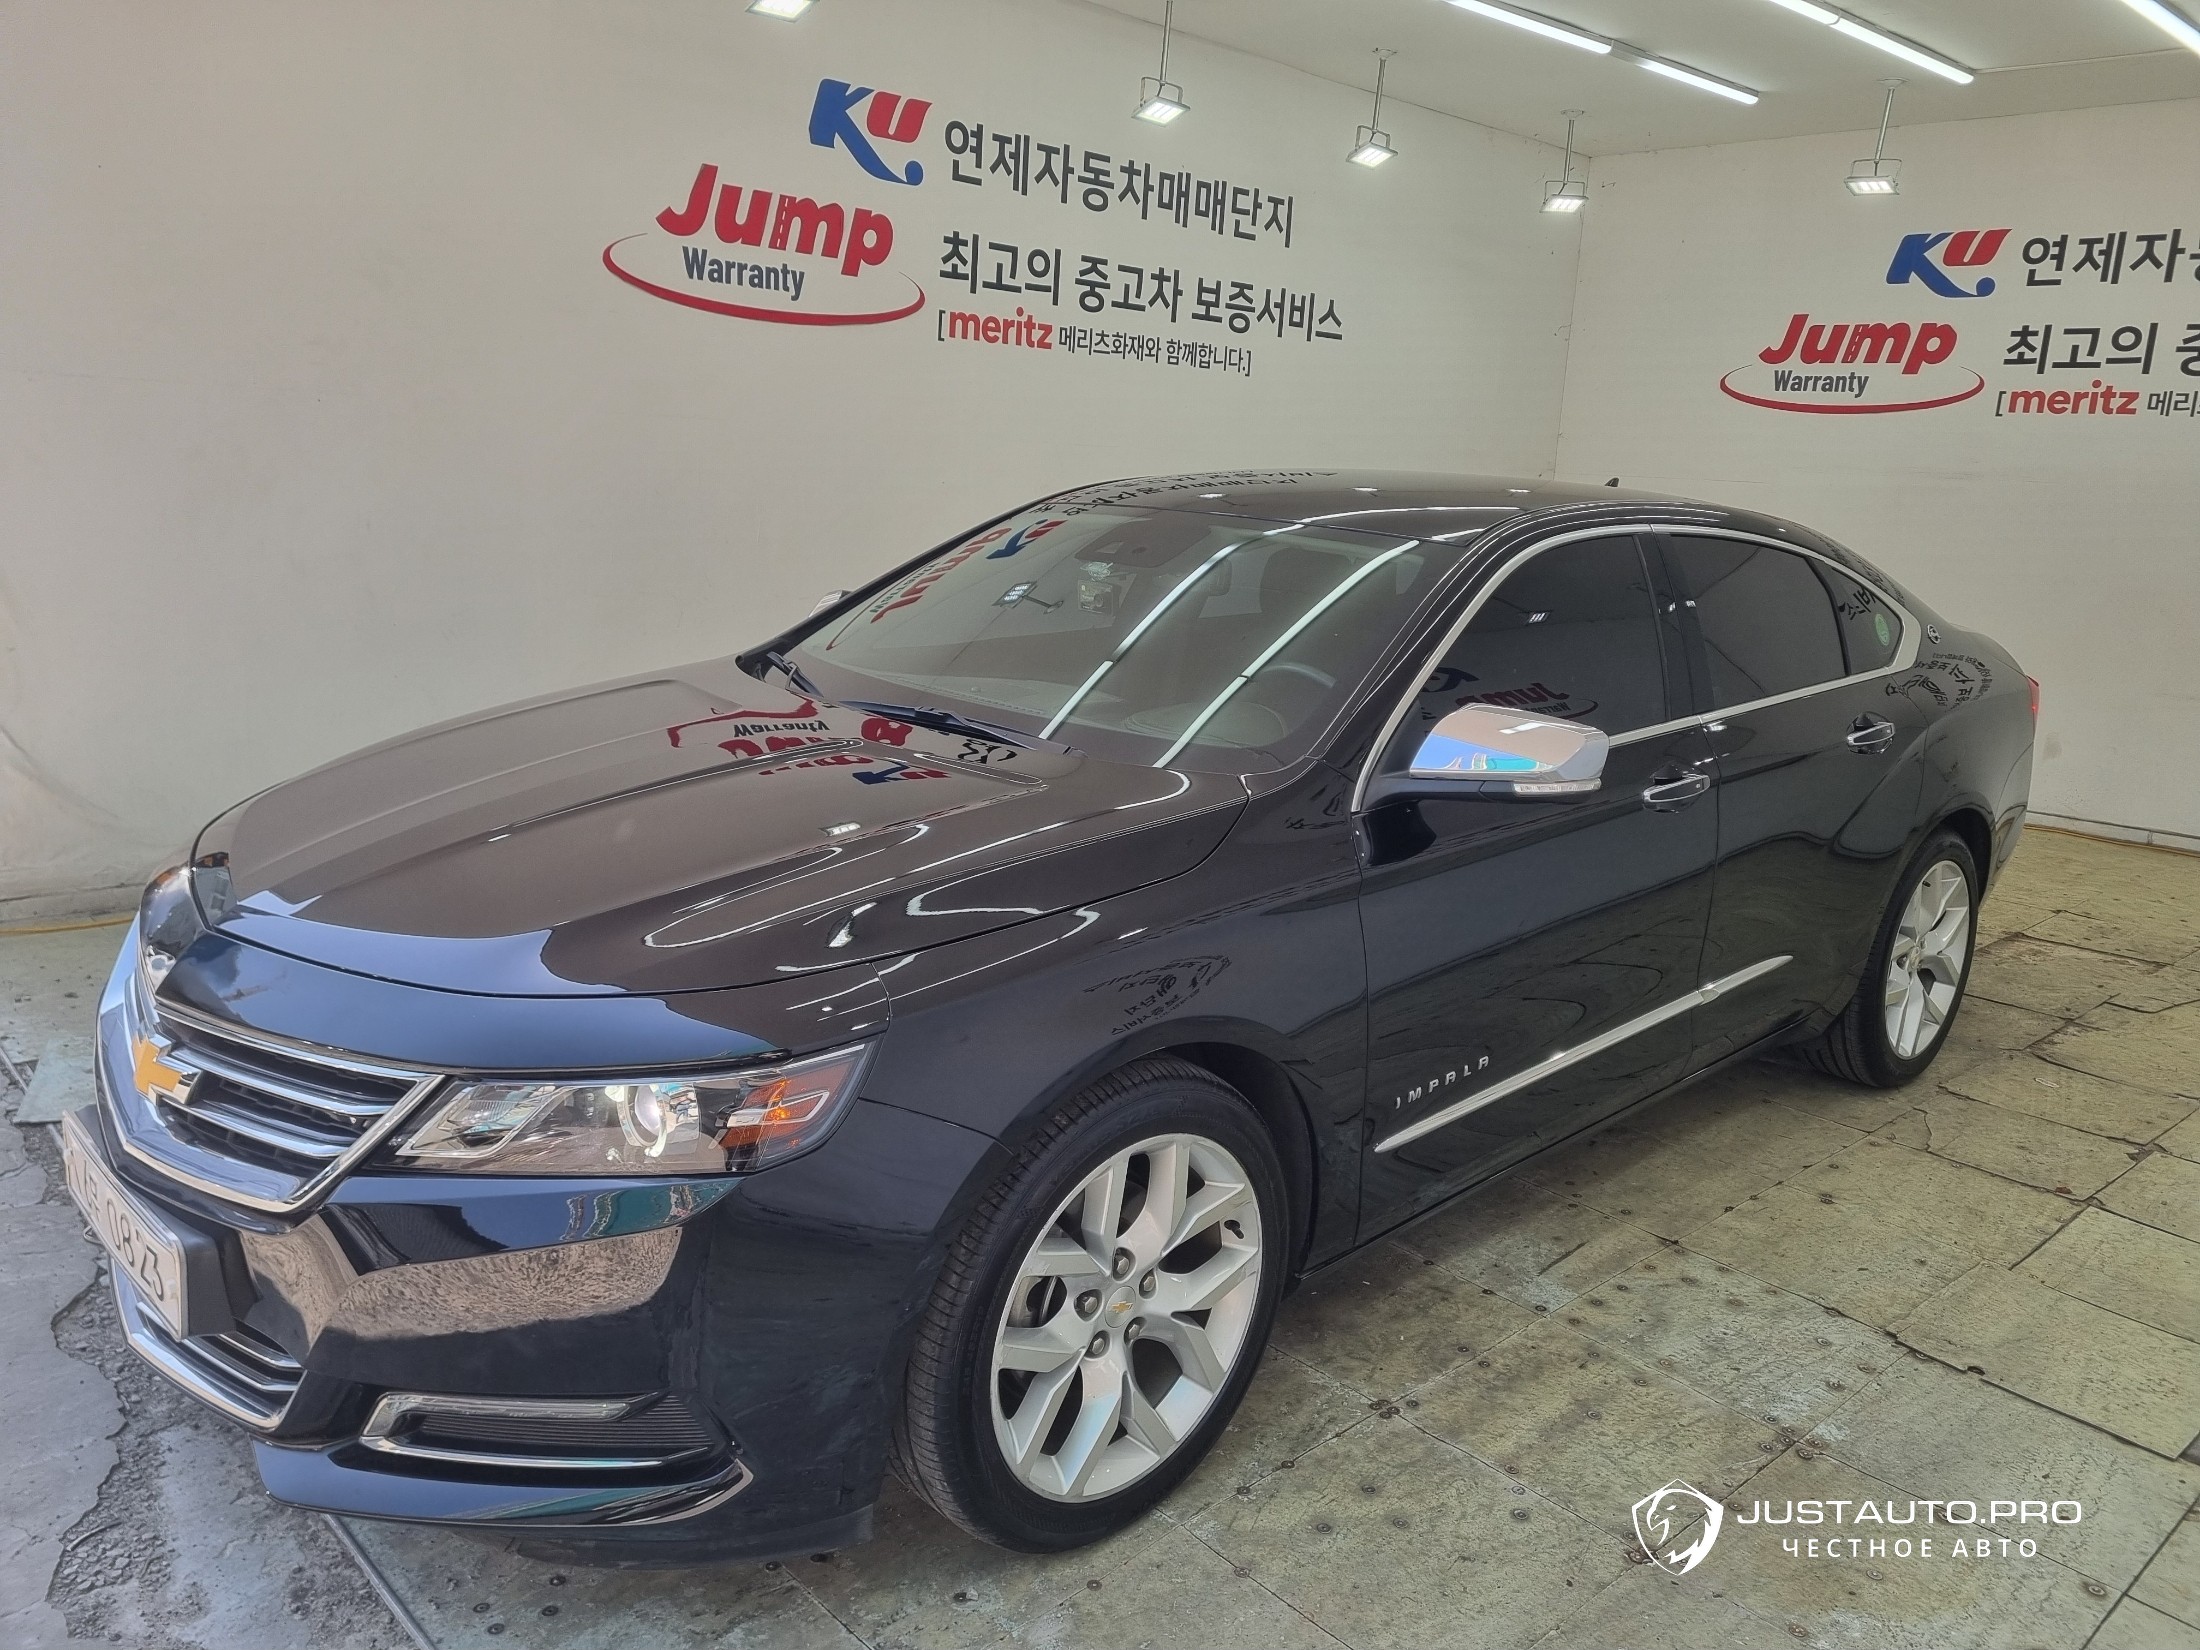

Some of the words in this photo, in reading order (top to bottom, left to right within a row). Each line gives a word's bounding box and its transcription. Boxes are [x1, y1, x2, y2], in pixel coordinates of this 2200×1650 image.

[943, 119, 1295, 249] 연제자동차매매단지
[656, 163, 894, 277] Jump
[682, 245, 805, 301] Warranty
[939, 229, 1063, 306] 최고의
[1073, 253, 1184, 323] 중고차
[1191, 276, 1344, 342] 보증서비스
[1058, 325, 1161, 363] 메리츠화재와
[1758, 313, 1958, 375] Jump
[2003, 322, 2159, 375] 최고의
[1774, 369, 1870, 398] Warranty
[2147, 390, 2200, 417] 메리
[1395, 1055, 1489, 1109] IMPALA
[107, 1197, 163, 1302] 0823
